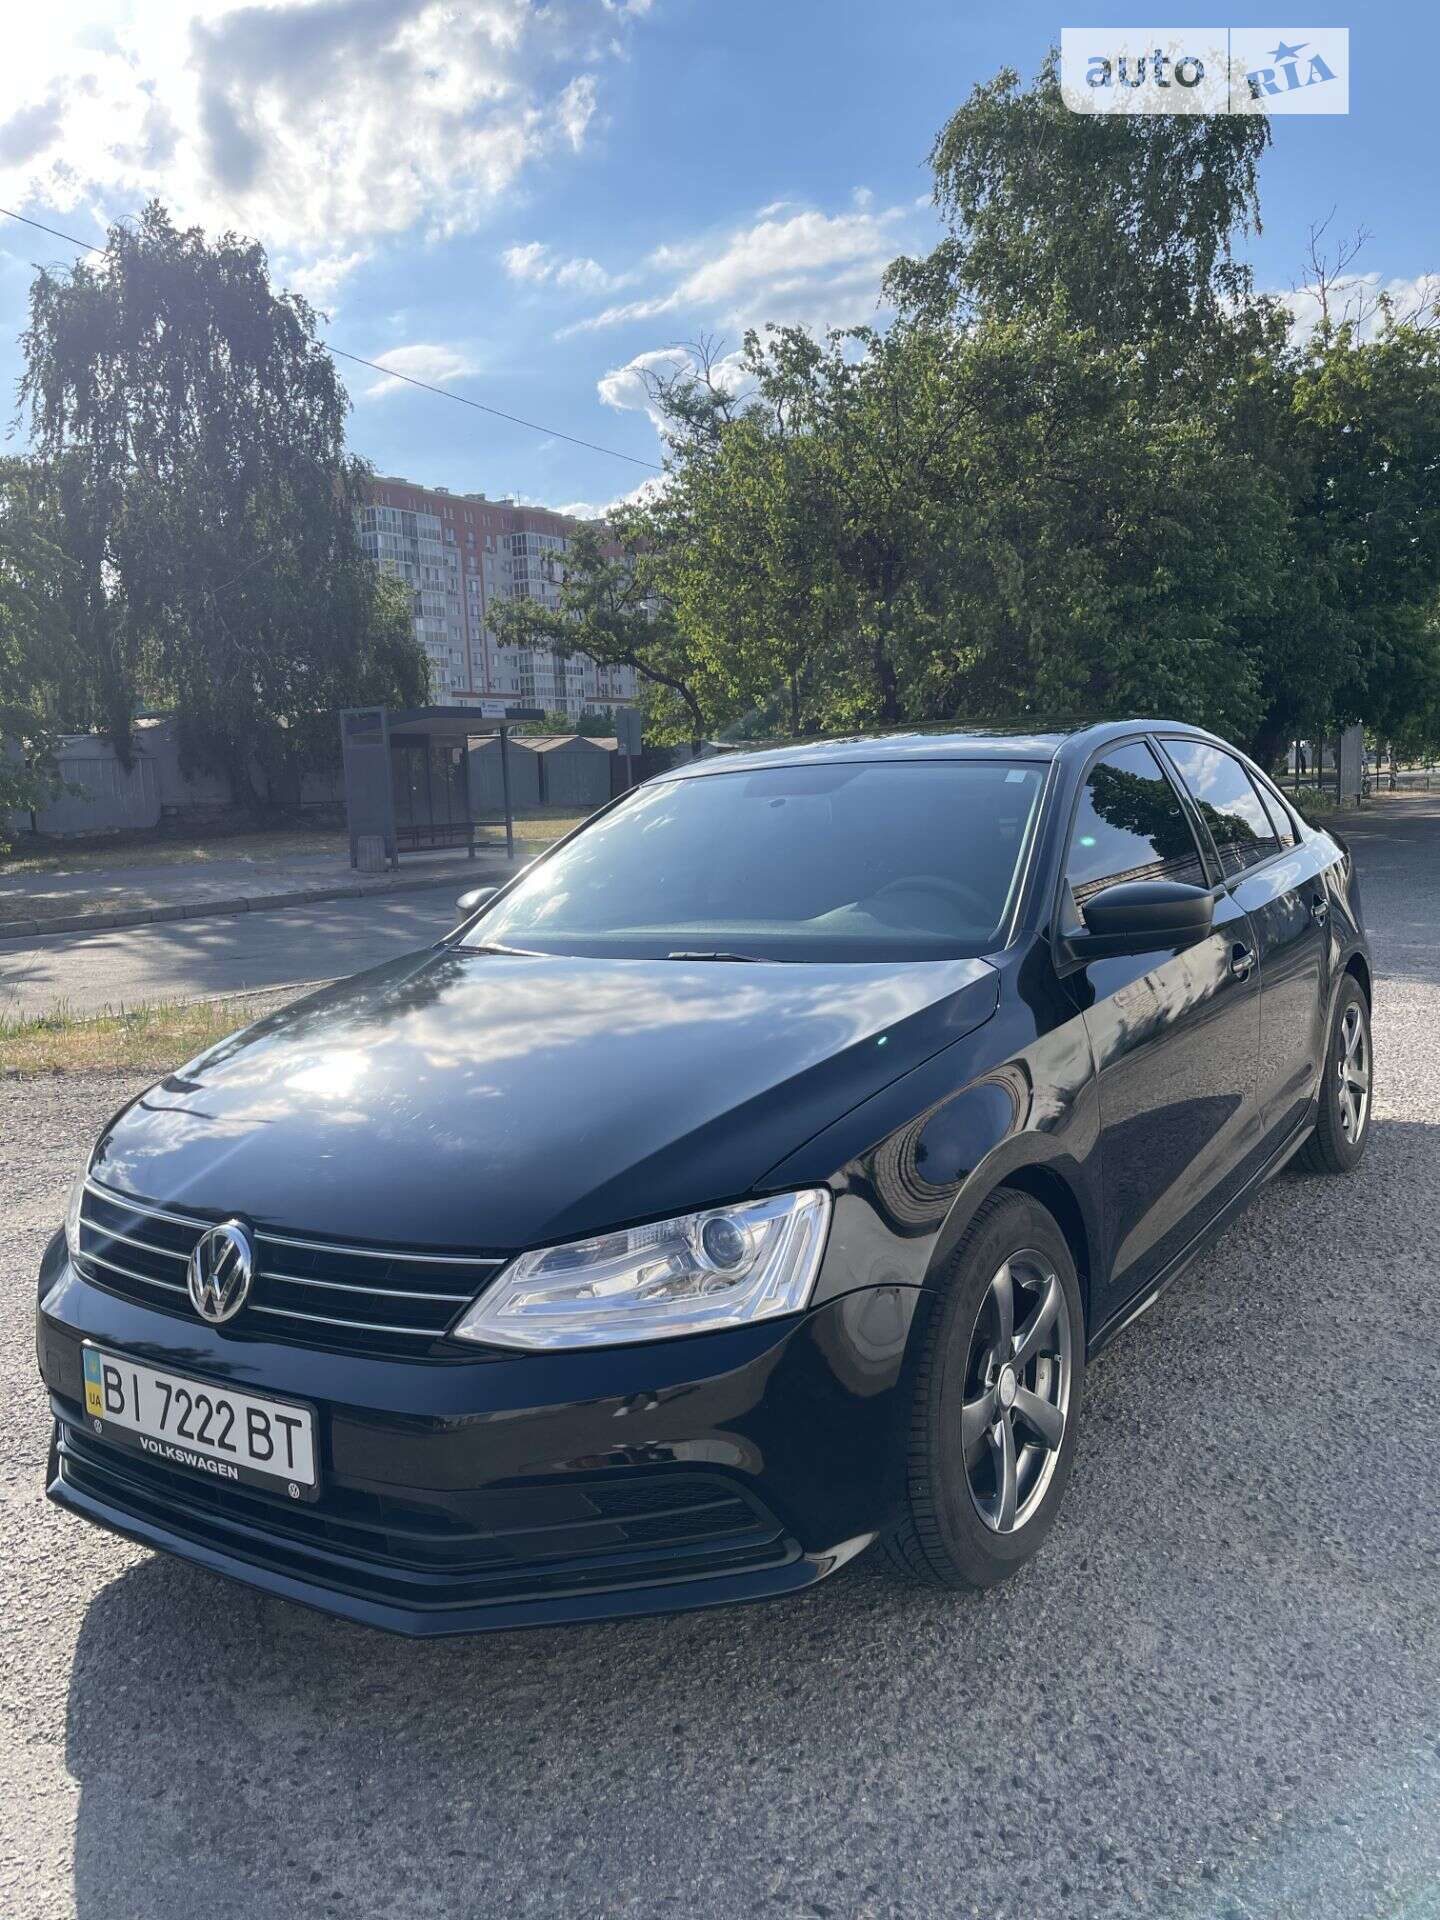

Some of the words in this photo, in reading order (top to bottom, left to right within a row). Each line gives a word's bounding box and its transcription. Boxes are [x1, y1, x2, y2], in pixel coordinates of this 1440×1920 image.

[89, 1393, 102, 1409] UA
[155, 1381, 236, 1452] 7222
[246, 1406, 302, 1469] BT
[139, 1436, 239, 1480] VOLKSWAGEN
